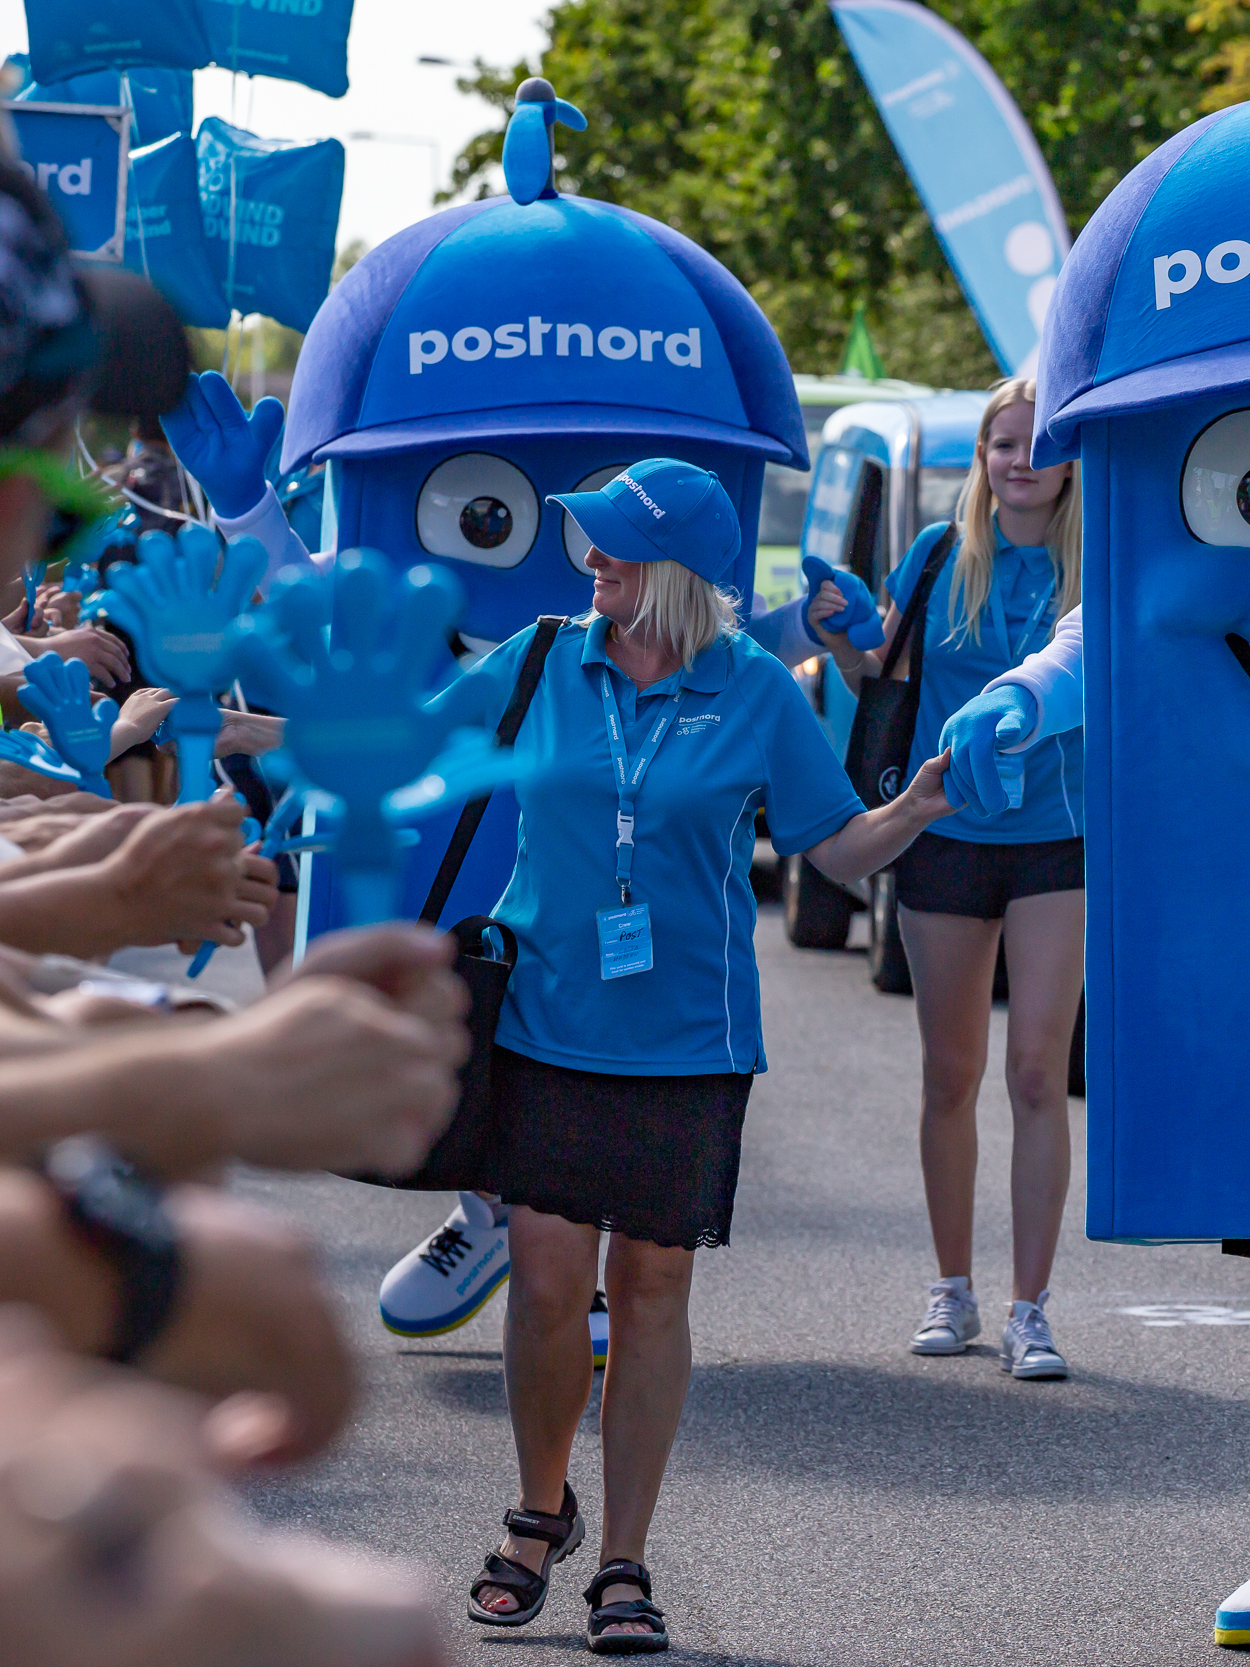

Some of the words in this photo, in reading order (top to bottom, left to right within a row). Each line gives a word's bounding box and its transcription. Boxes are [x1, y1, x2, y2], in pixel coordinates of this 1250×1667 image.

[409, 316, 701, 375] postnord
[618, 474, 666, 520] postnord
[609, 714, 619, 741] postnord
[651, 717, 667, 743] postnord
[678, 713, 721, 724] postnord
[631, 757, 647, 785] postnord
